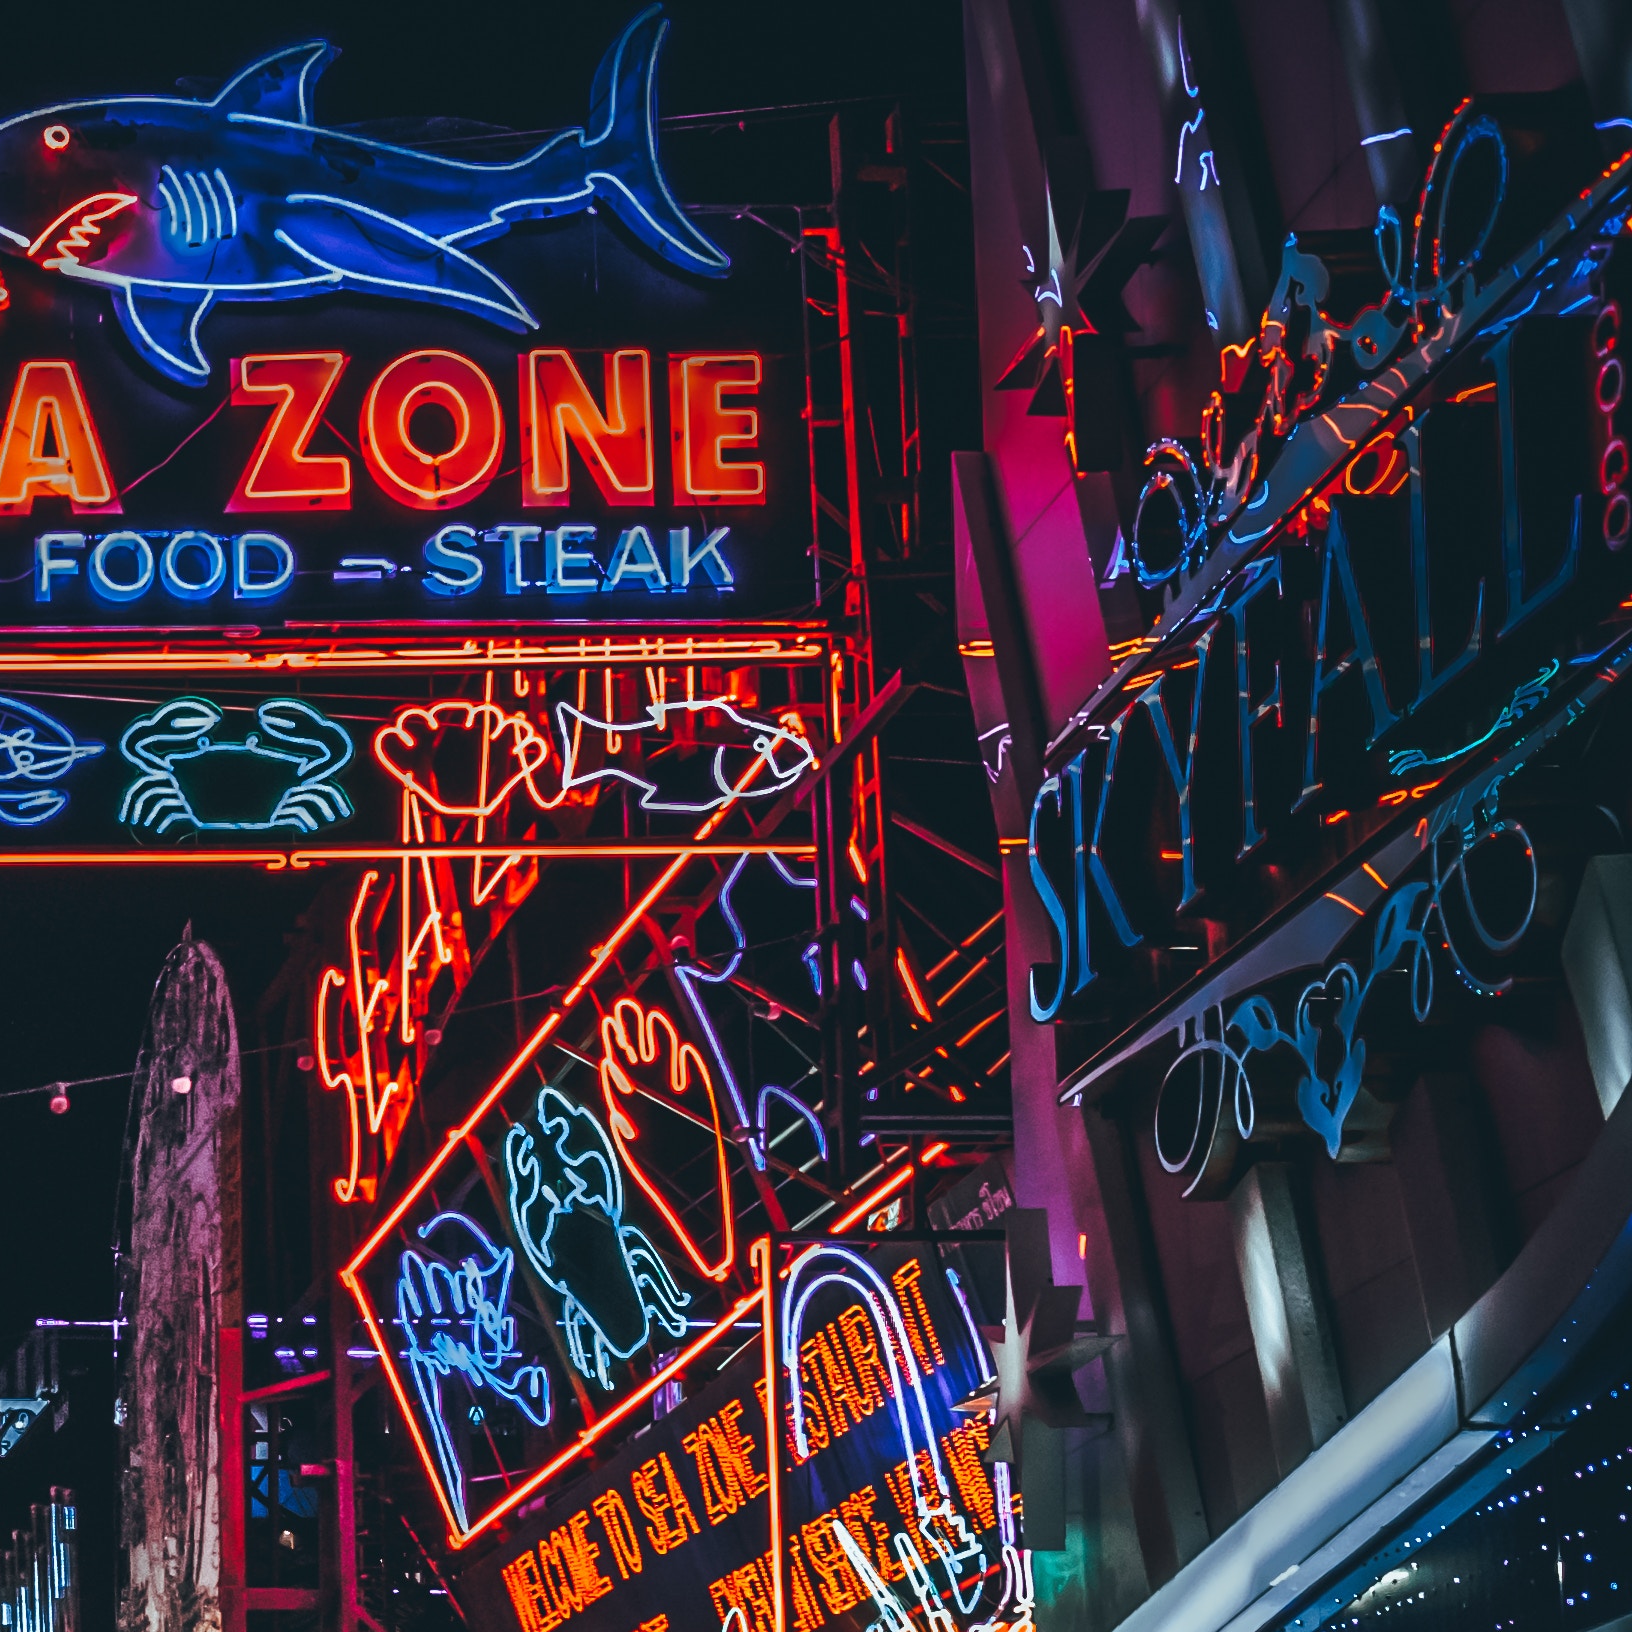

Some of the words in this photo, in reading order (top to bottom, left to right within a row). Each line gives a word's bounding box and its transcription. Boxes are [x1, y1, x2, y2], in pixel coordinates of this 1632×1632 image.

[223, 349, 766, 513] ZONE
[35, 529, 296, 602] FOOD
[421, 522, 736, 596] STEAK
[592, 1488, 643, 1580] TO
[631, 1451, 701, 1555] SEA
[682, 1399, 770, 1526] ZONE
